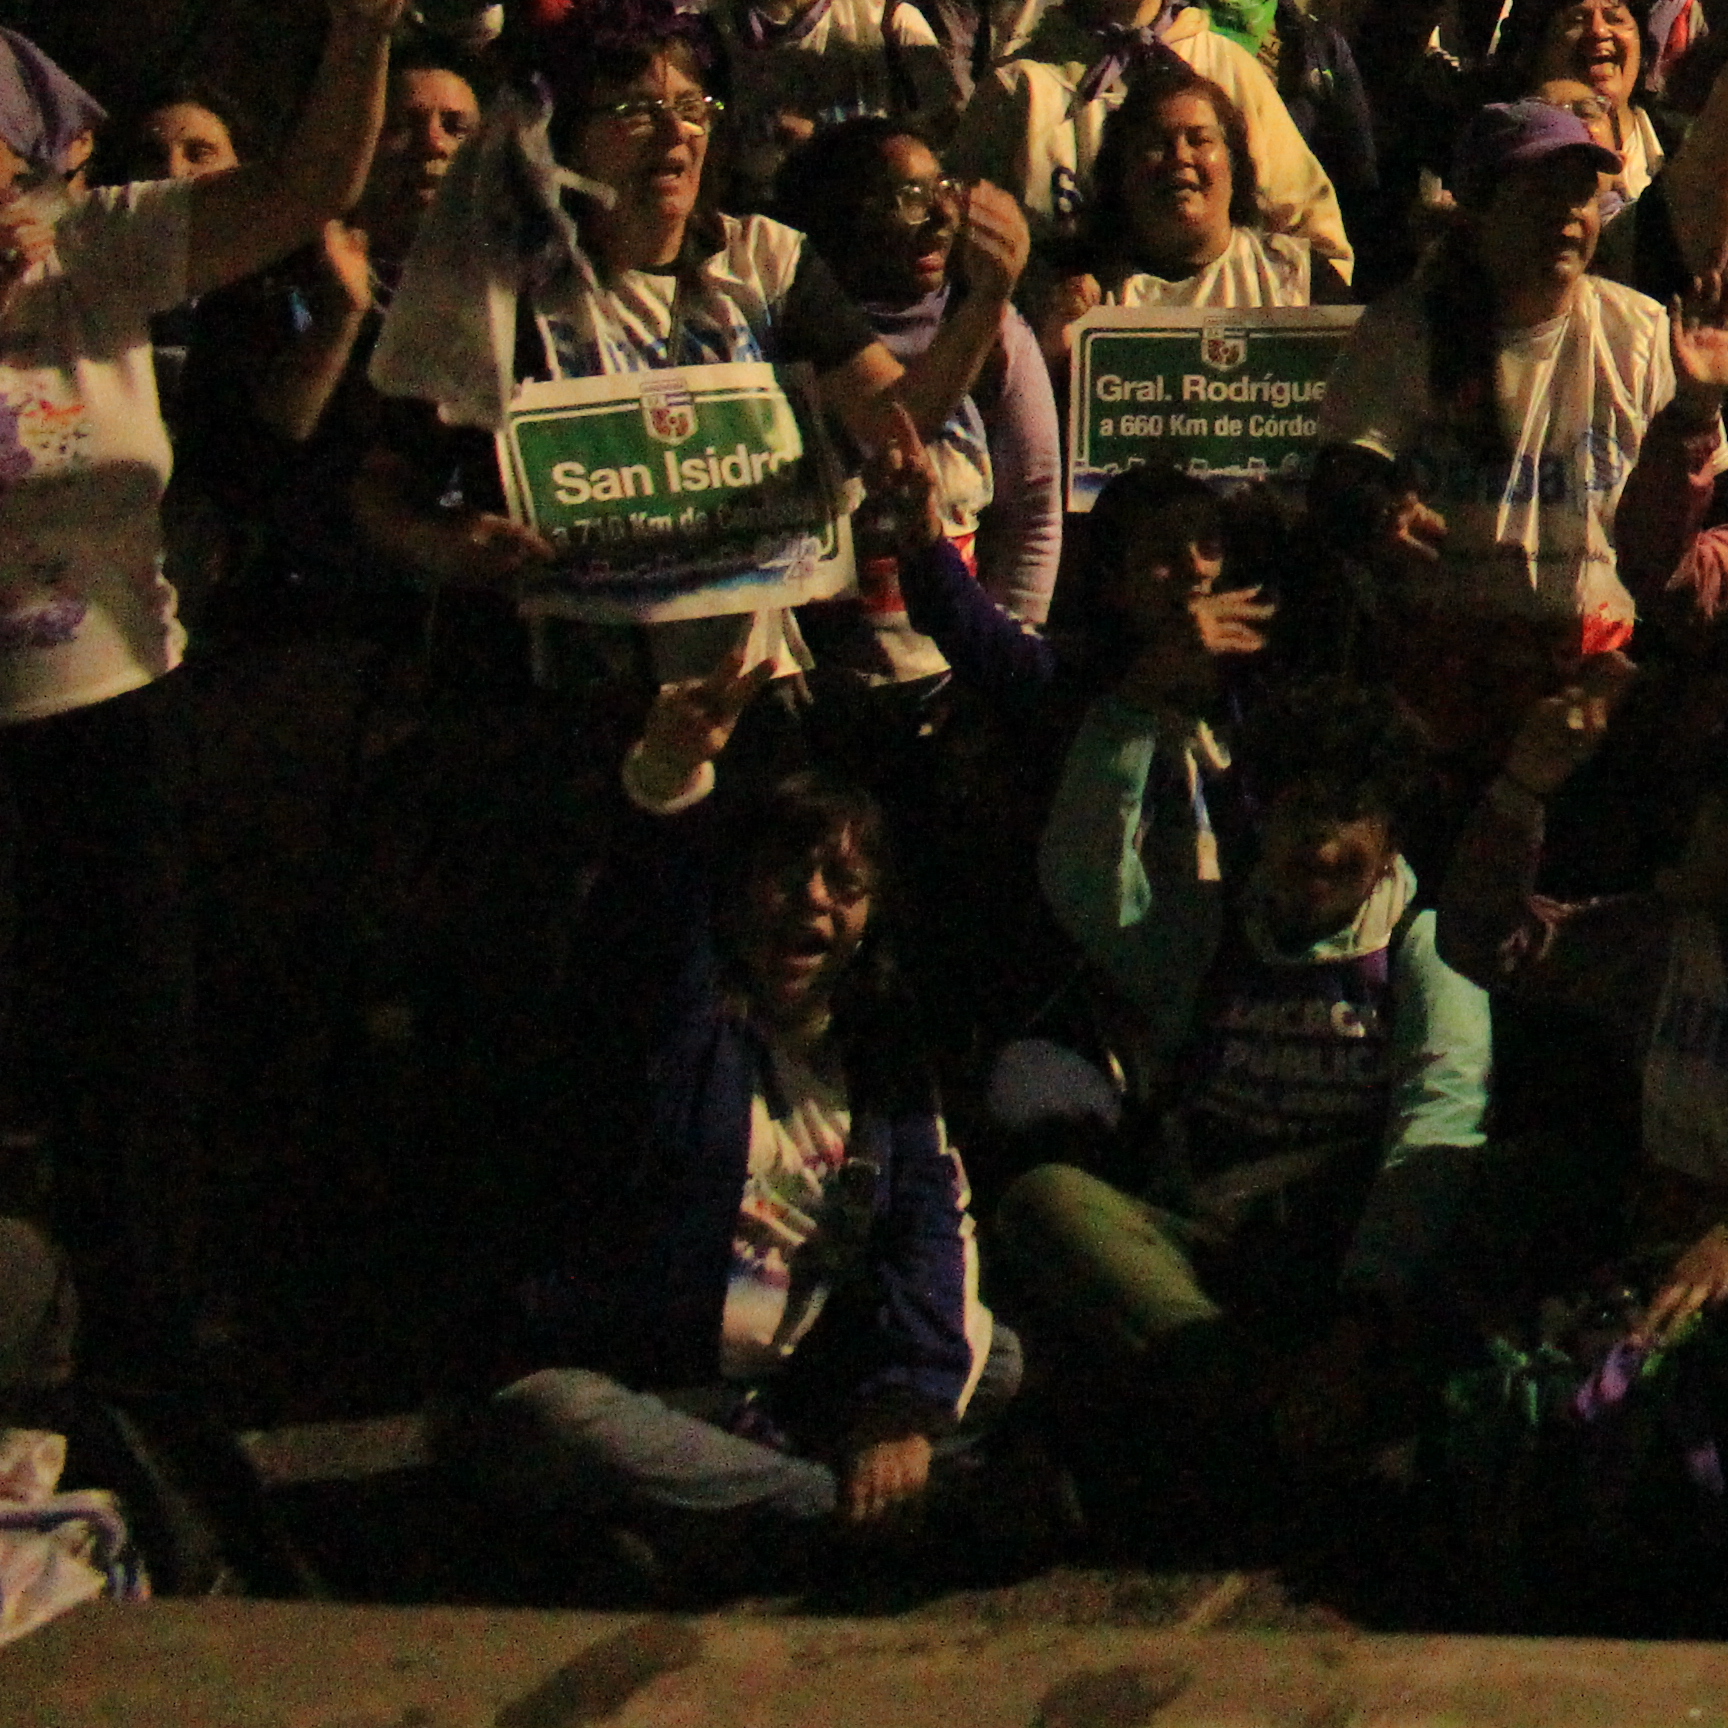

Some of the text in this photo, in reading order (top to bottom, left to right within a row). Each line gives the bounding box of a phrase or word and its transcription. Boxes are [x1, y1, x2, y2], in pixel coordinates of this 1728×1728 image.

[1096, 372, 1328, 409] Gral. Rodrígue
[1100, 413, 1318, 438] a 660 Km de Córdo
[552, 460, 655, 505] San
